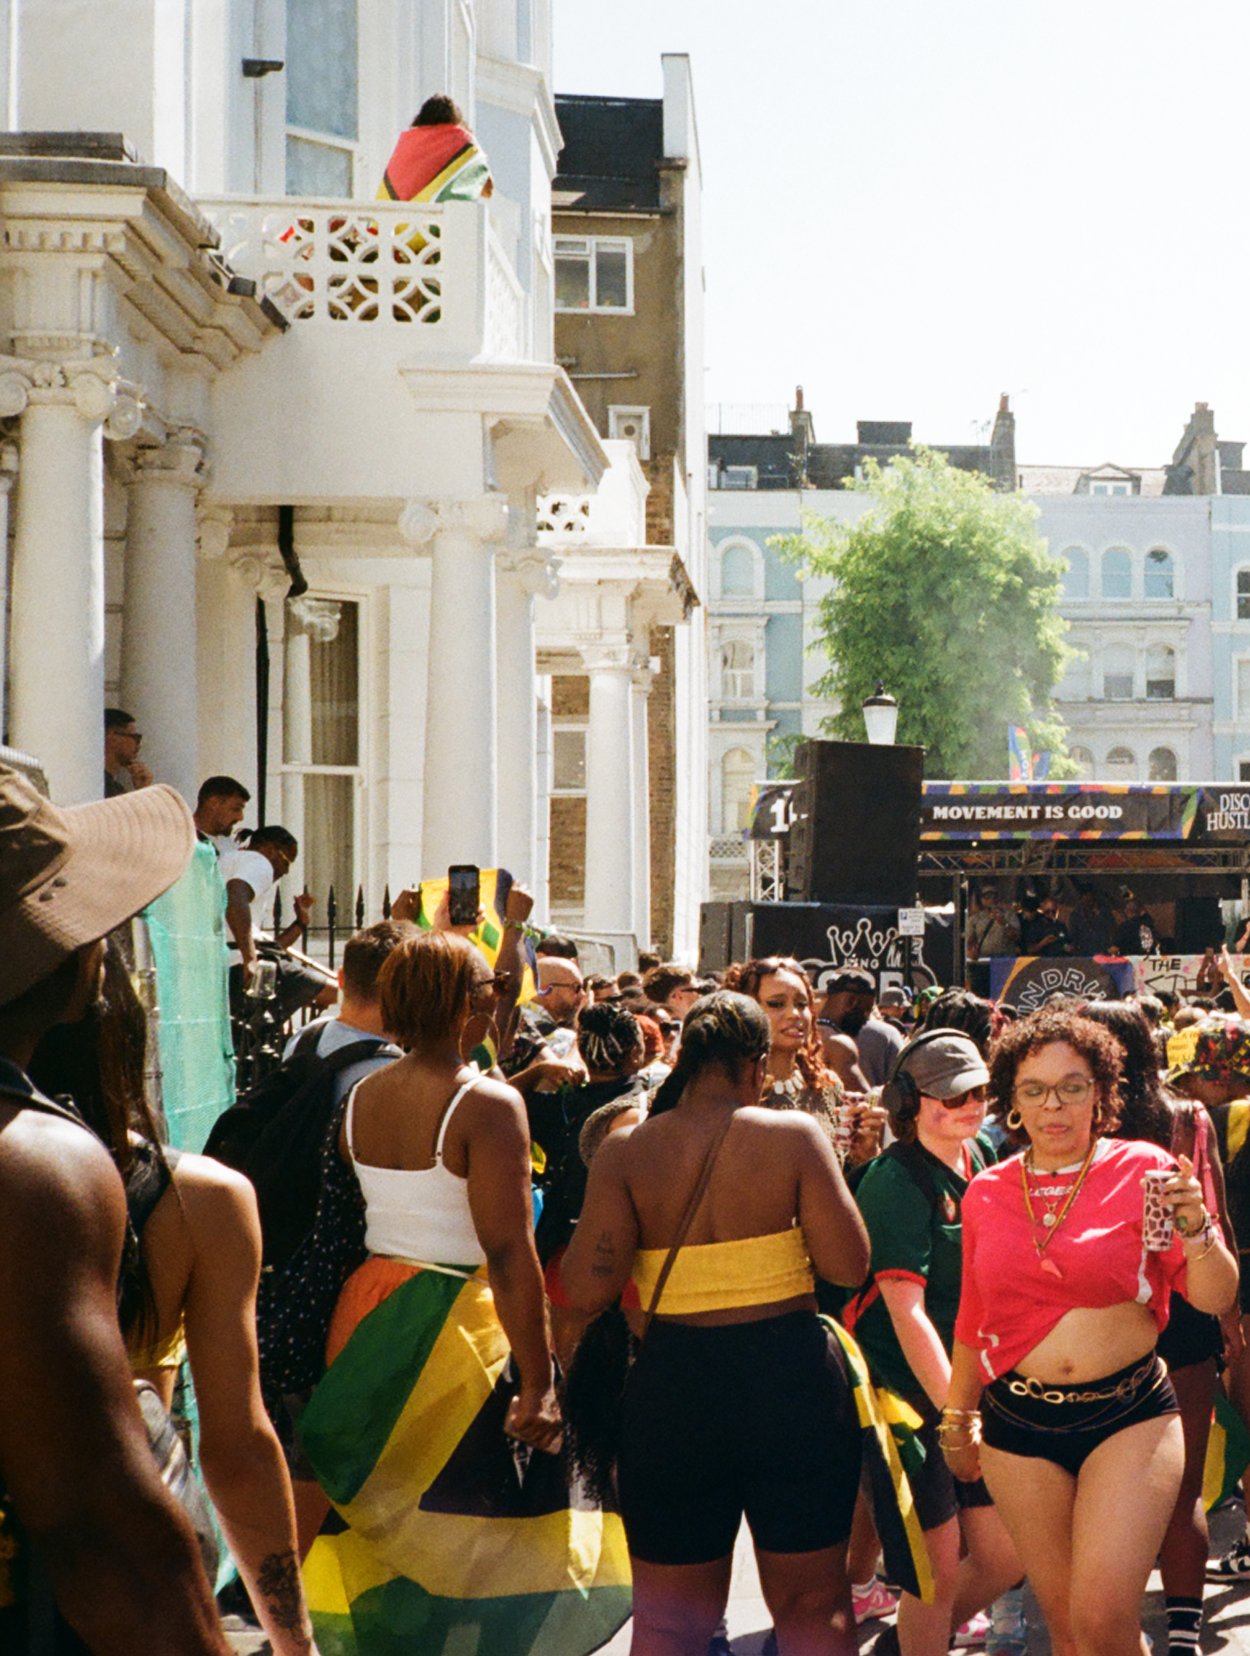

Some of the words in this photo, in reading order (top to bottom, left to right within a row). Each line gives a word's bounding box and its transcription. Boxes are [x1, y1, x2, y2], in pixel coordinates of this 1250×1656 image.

[932, 805, 1041, 820] MOVEMENT
[1044, 805, 1064, 820] IS
[1067, 805, 1123, 820] GOOD
[1148, 958, 1181, 972] THE
